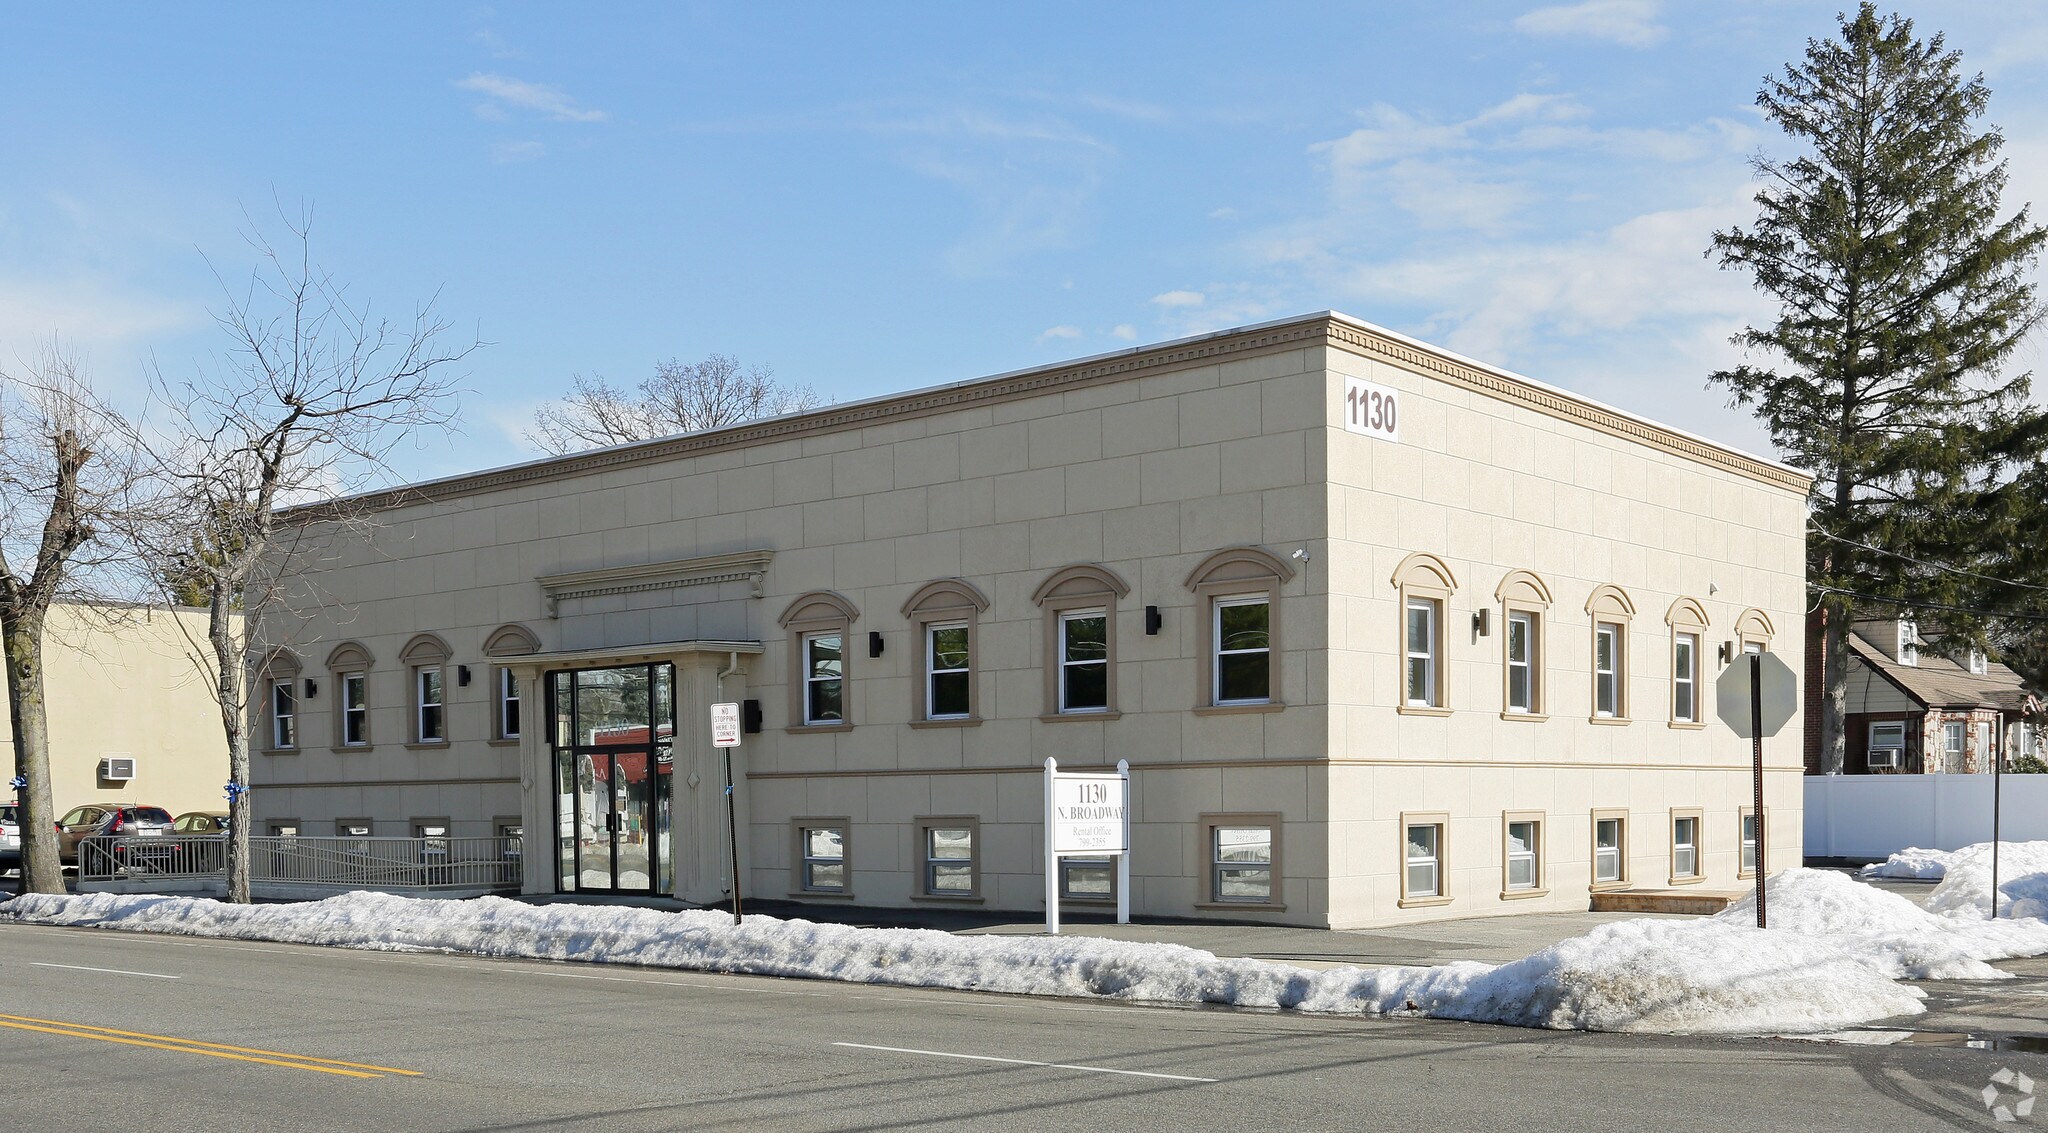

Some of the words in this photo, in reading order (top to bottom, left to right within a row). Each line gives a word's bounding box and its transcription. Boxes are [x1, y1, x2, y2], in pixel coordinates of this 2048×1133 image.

[1347, 386, 1396, 433] 1130
[721, 707, 729, 715] NO
[1079, 783, 1107, 804] 1130
[1058, 806, 1068, 820] N.
[1070, 806, 1125, 820] BROADWAY
[1072, 826, 1093, 836] Rental
[1093, 825, 1112, 836] Office
